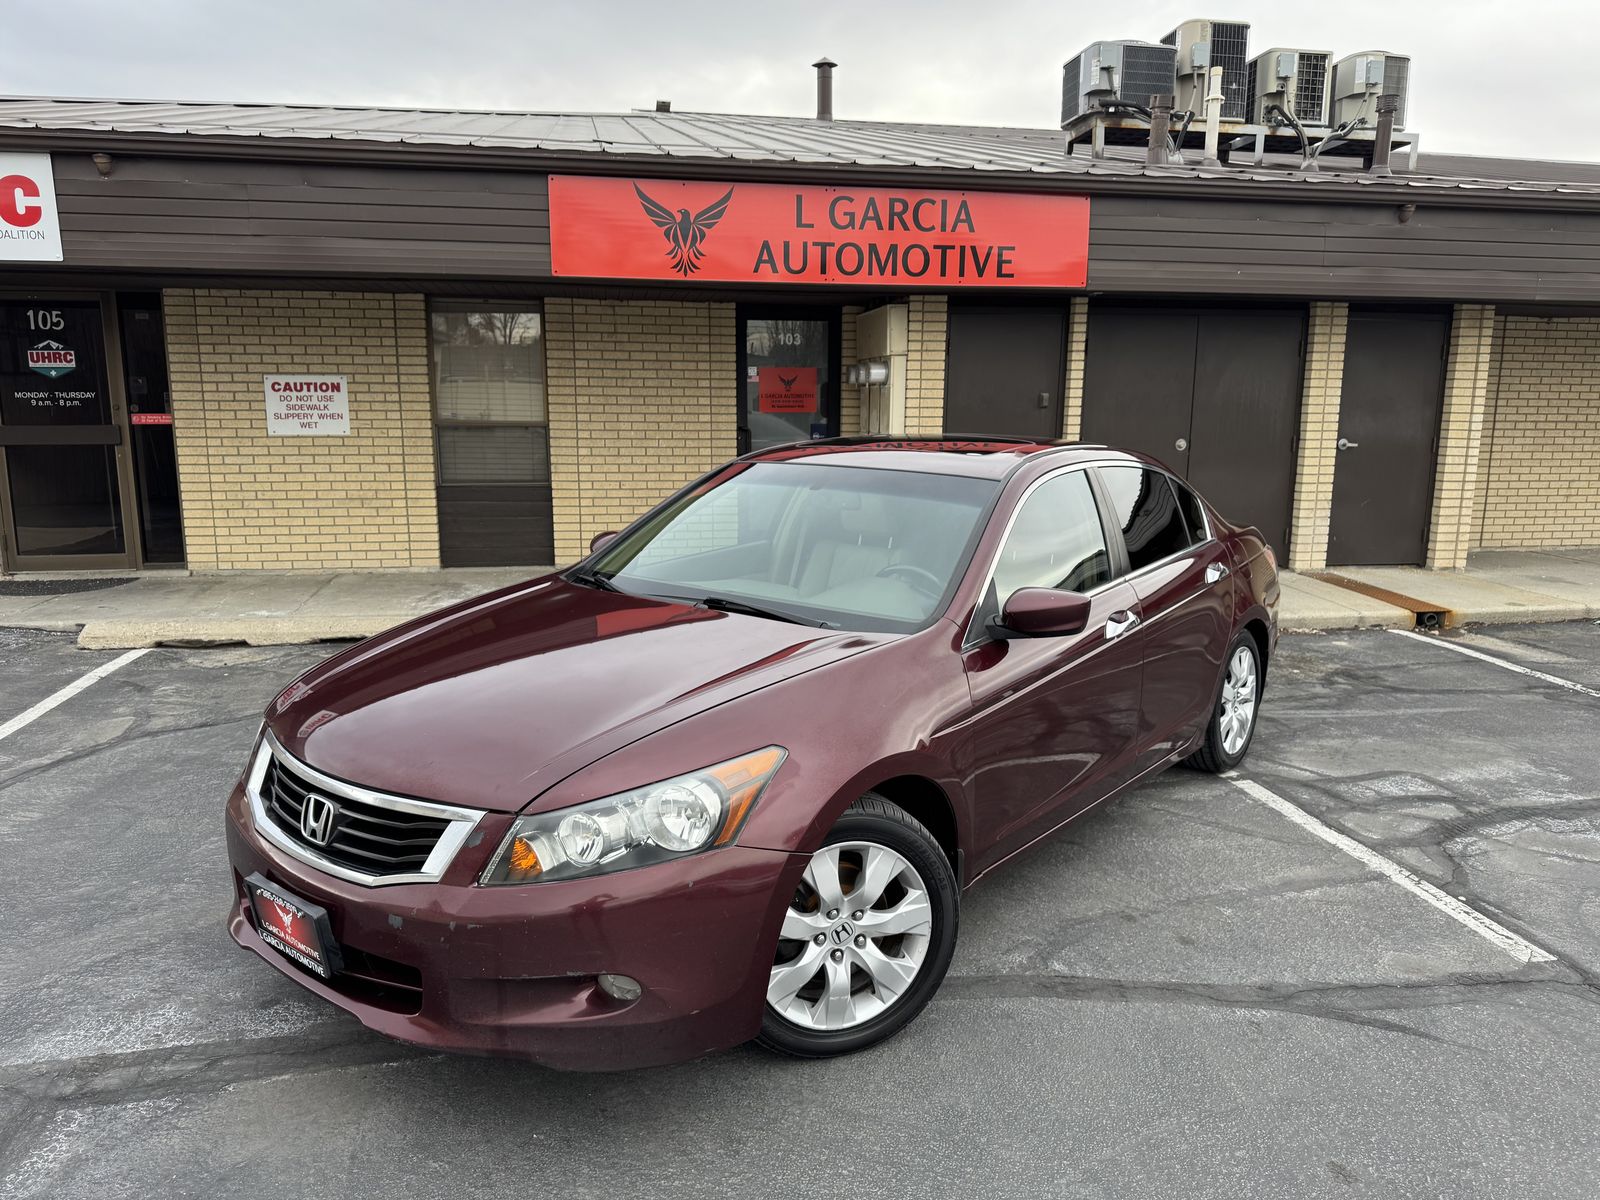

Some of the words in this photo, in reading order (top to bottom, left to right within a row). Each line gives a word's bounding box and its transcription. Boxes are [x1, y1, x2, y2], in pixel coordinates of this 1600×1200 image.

[795, 194, 815, 229] L
[828, 195, 976, 233] GARCIA
[752, 240, 1017, 279] AUTOMOTIVE
[26, 309, 65, 331] 105
[778, 333, 802, 346] 103
[28, 351, 75, 364] UHRC
[270, 381, 341, 392] CAUTION
[14, 391, 49, 399] MONDAY
[54, 391, 96, 399] THURSDAY
[279, 394, 293, 402] DO
[295, 394, 314, 402] NOT
[316, 394, 335, 402] USE
[285, 403, 330, 411] SIDEWALK
[273, 412, 314, 420] SLIPPERY
[317, 412, 344, 420] WHEN
[299, 421, 319, 429] WET
[285, 933, 321, 960] AUTOMOTIVE
[263, 932, 286, 952] GARCIA
[286, 947, 326, 978] AUTOMOTIVE
